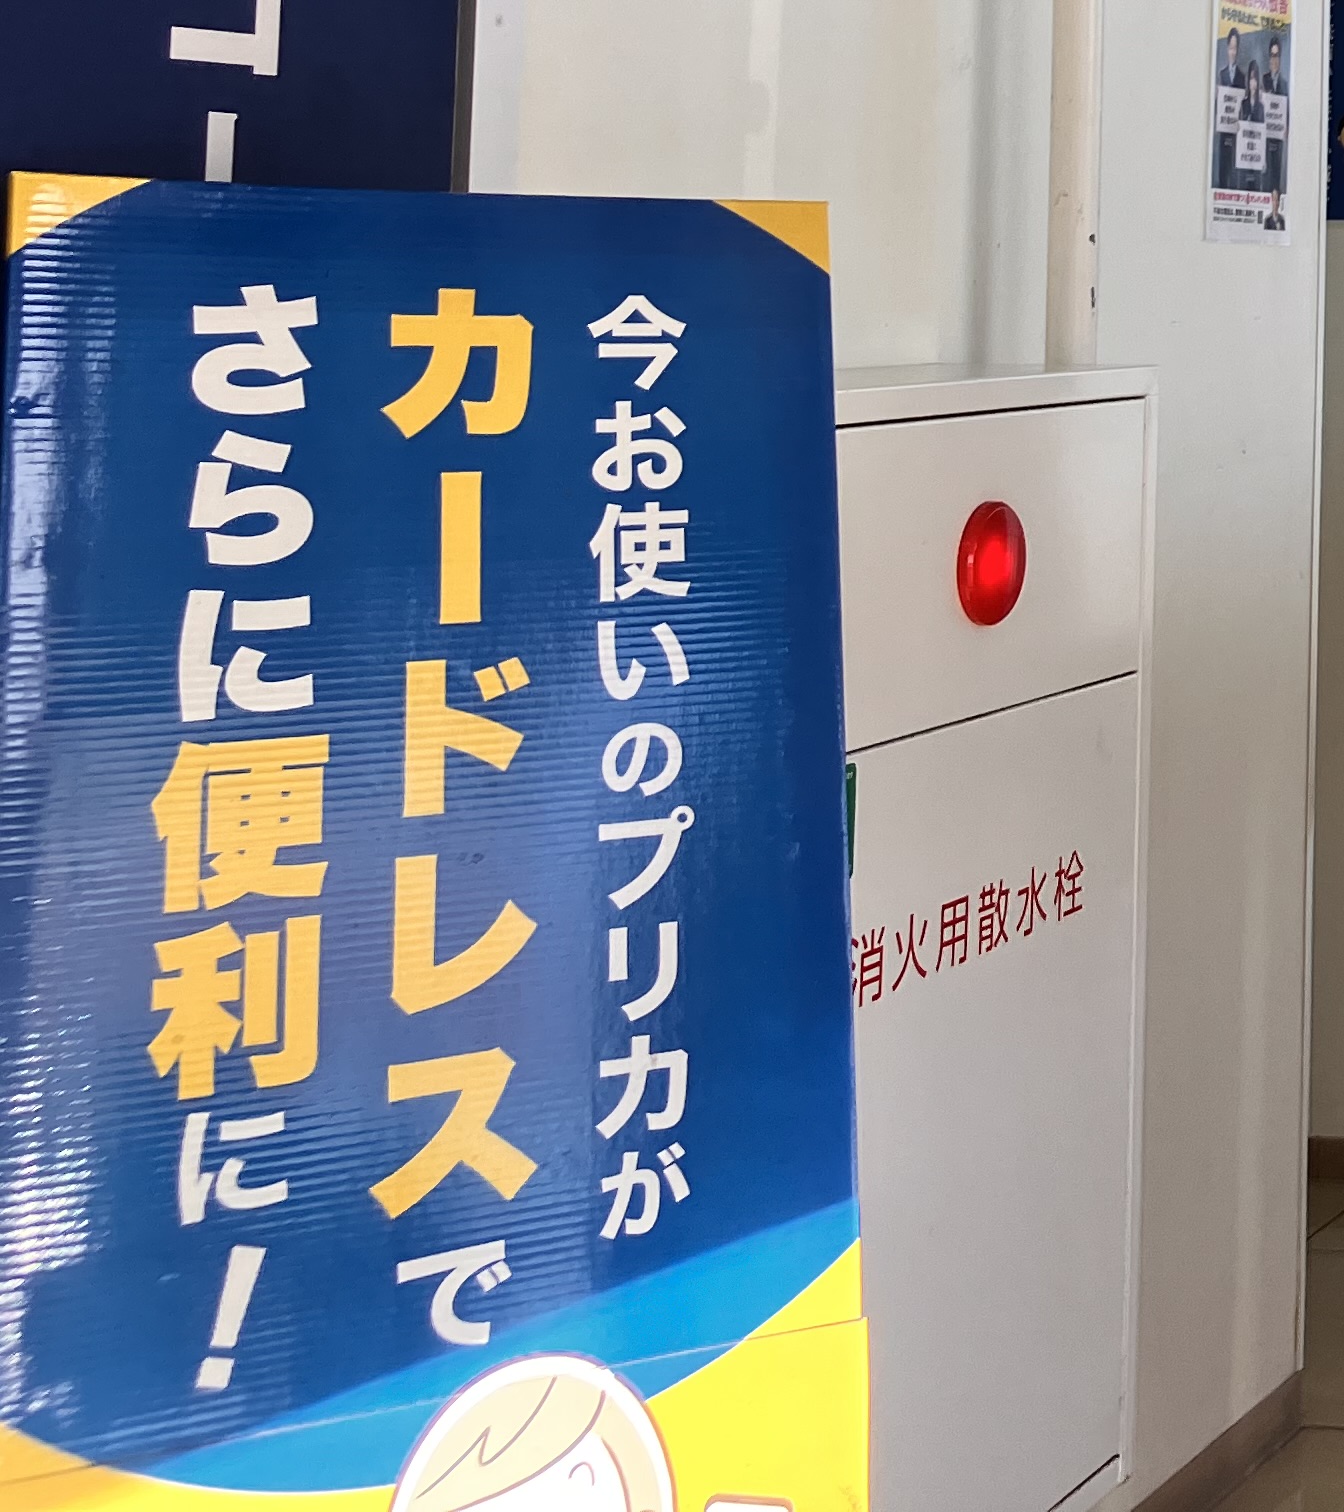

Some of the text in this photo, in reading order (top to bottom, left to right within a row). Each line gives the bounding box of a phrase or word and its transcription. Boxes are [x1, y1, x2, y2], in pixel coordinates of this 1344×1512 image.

[148, 284, 330, 1392] さらに便利に!
[368, 288, 540, 1347] カードレスで
[587, 294, 696, 1242] 今お使いのプリカが
[851, 850, 1084, 1007] 消火用散水栓
